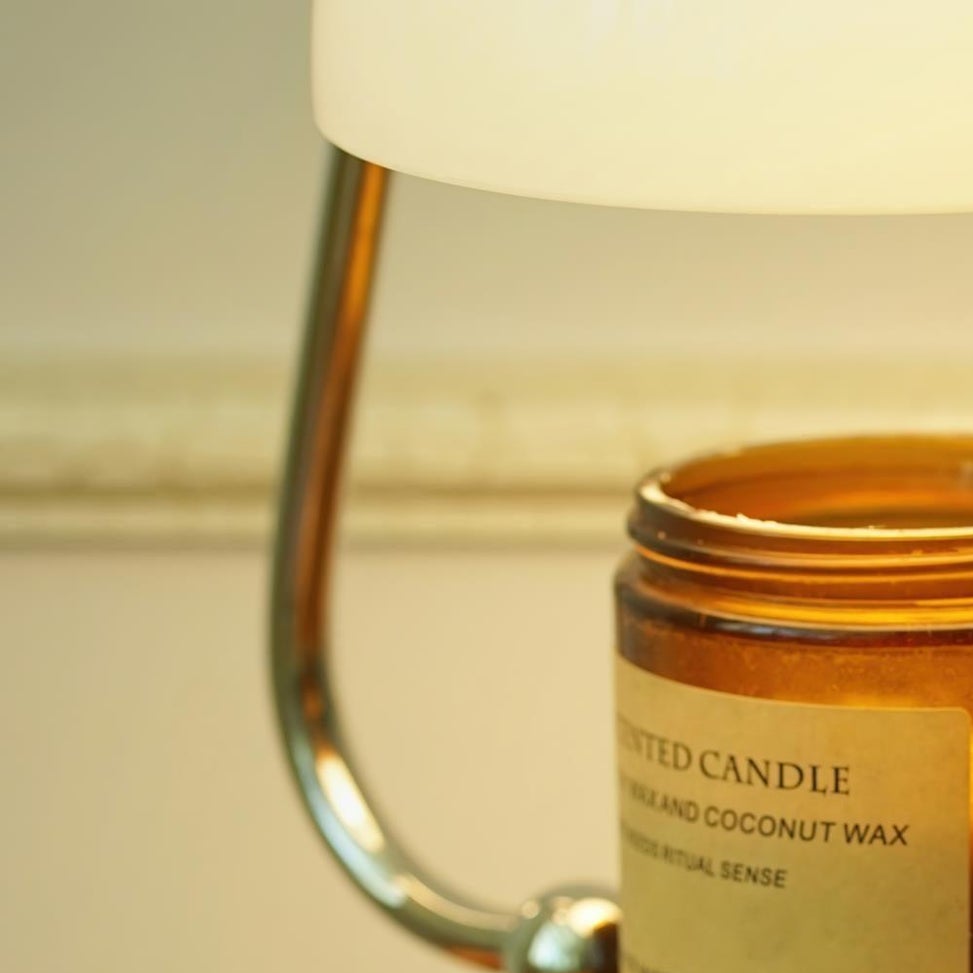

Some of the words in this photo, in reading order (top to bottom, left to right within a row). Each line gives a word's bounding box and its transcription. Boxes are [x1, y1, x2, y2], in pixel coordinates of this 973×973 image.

[699, 749, 851, 796] CANDLE
[660, 793, 700, 824] AND
[704, 805, 836, 844] COCONUT
[843, 823, 910, 846] WAX
[720, 860, 788, 889] SENSE
